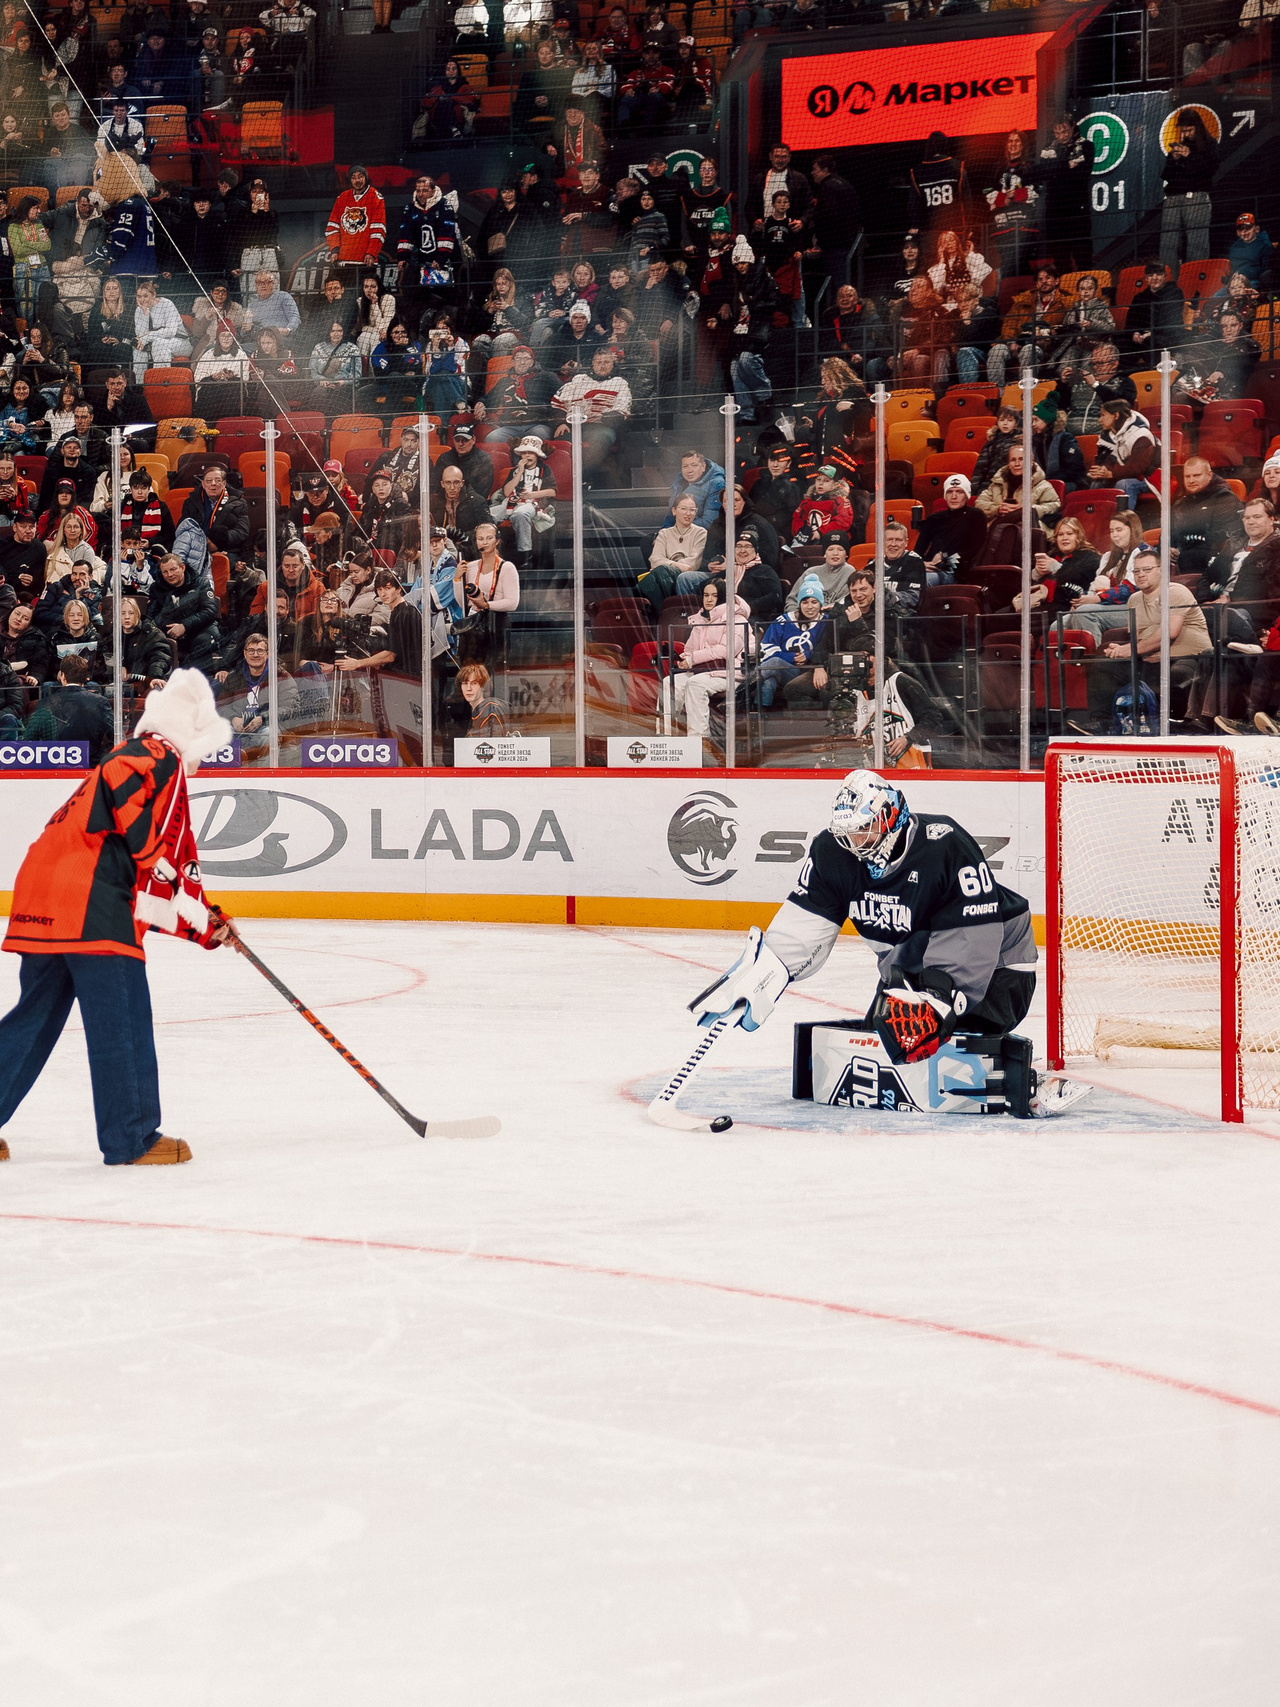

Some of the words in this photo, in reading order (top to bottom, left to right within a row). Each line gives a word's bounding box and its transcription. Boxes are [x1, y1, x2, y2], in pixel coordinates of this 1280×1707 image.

[883, 75, 1035, 105] Маркет
[924, 184, 953, 207] 168
[371, 808, 574, 862] LADA
[958, 862, 993, 897] 60
[864, 891, 900, 904] FONBET
[962, 902, 999, 916] FONBET
[300, 1009, 373, 1079] SOYUZ
[659, 1020, 728, 1101] WARRIOR
